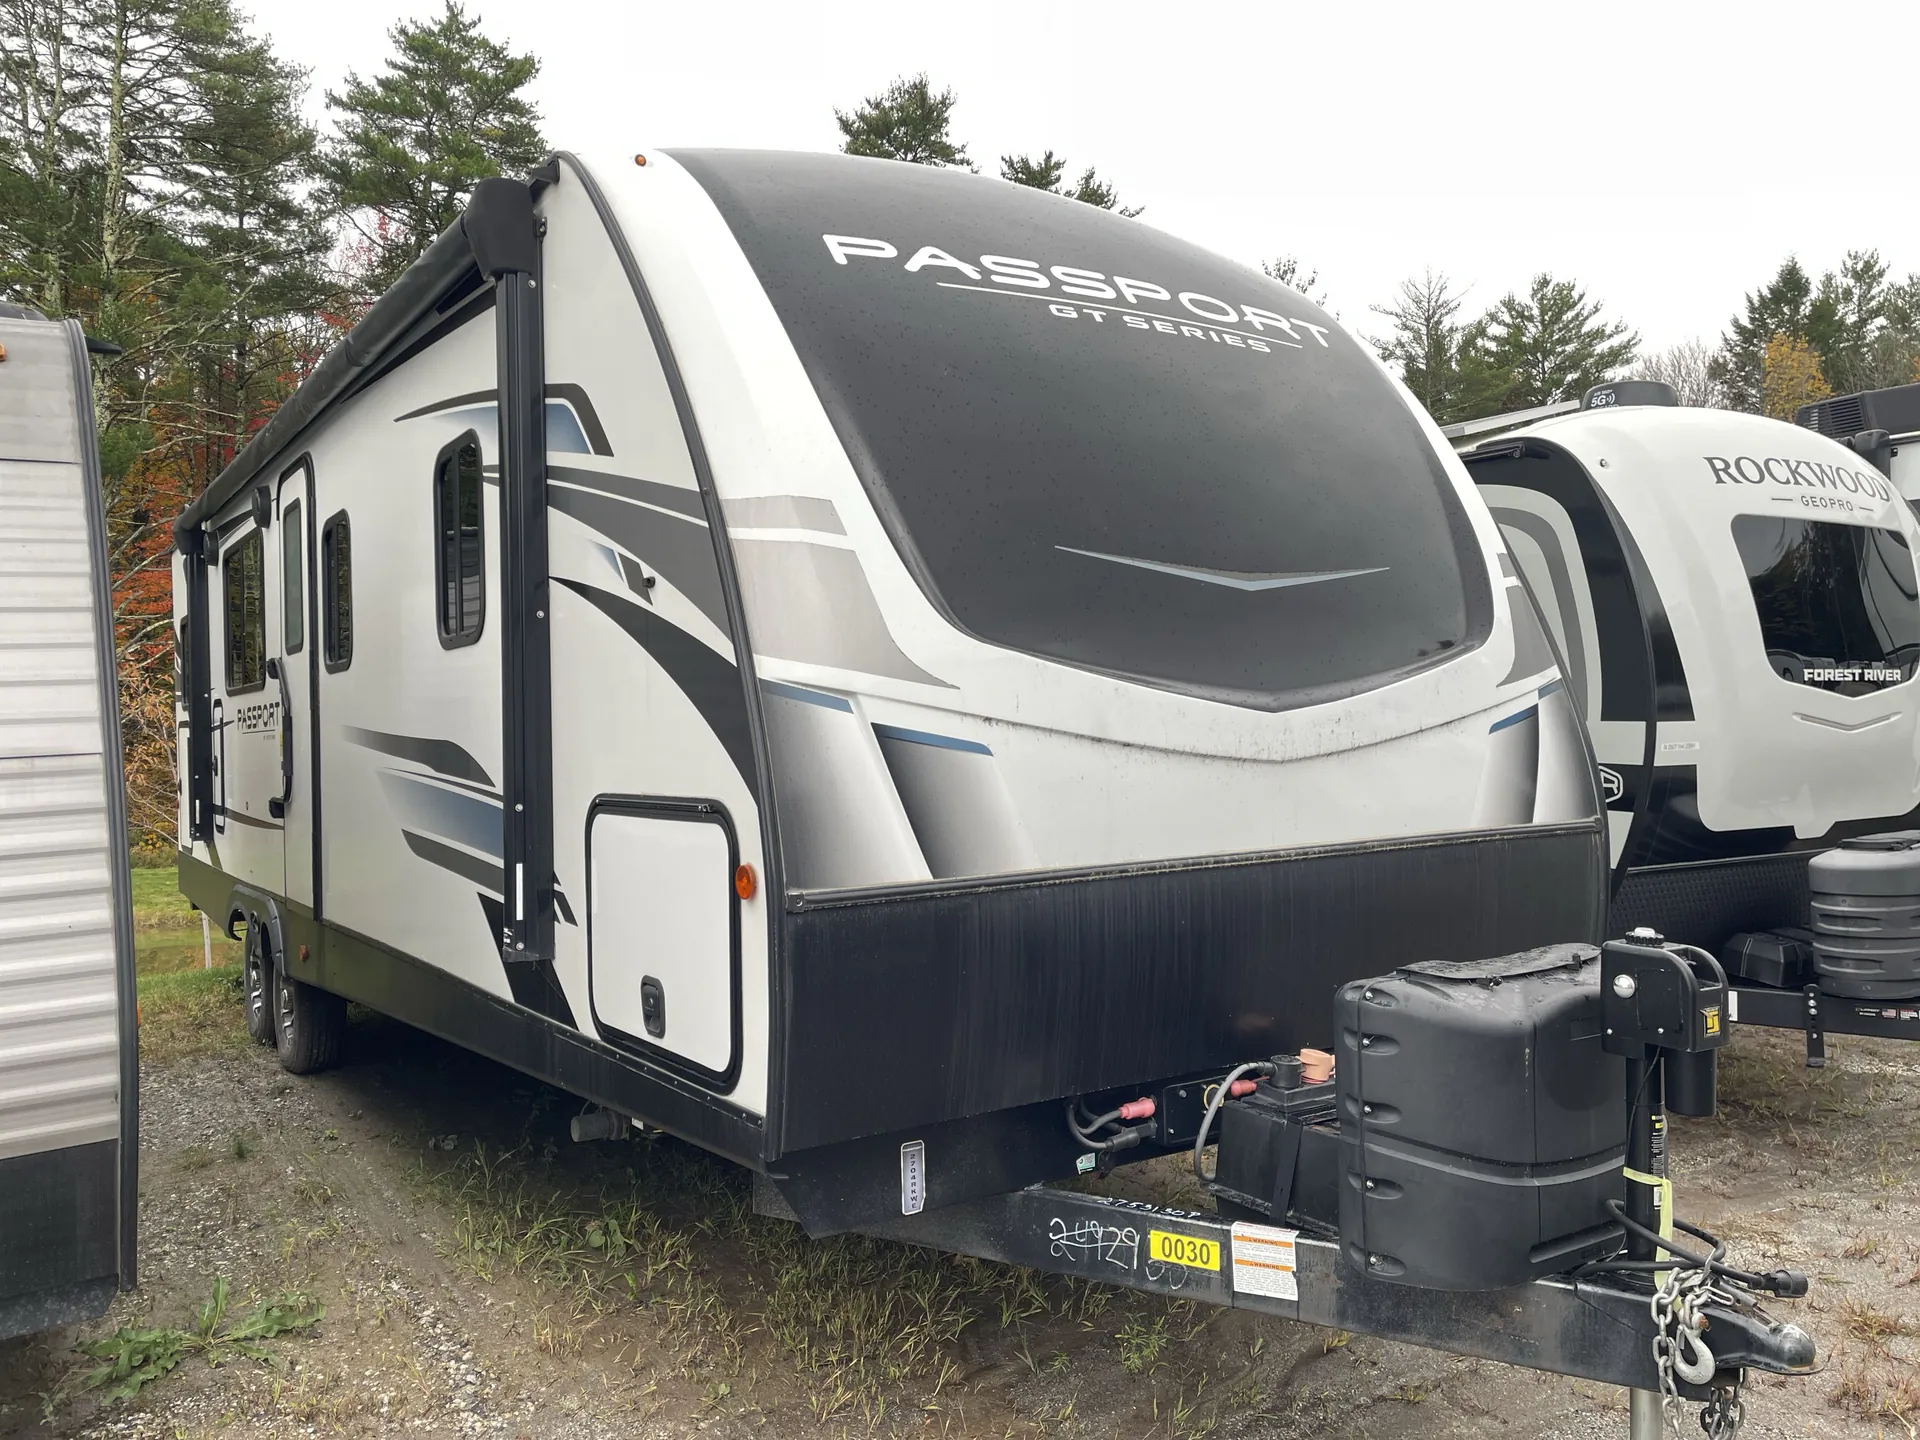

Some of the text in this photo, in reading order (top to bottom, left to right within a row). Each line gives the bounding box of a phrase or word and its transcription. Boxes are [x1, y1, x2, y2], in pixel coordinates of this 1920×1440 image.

[822, 233, 1330, 348] PASSPORT
[1048, 303, 1272, 353] GT SERIES
[1590, 394, 1607, 408] 5G
[1702, 455, 1891, 503] ROCKWOOD
[1800, 495, 1854, 512] GEOPRO
[1803, 668, 1902, 682] FOREST RIVER
[236, 701, 281, 731] PASSPORT
[909, 1153, 918, 1209] 2704RKWE
[1161, 1236, 1211, 1266] 0030
[1253, 1237, 1279, 1247] WARNING
[1254, 1261, 1280, 1271] WARNING
